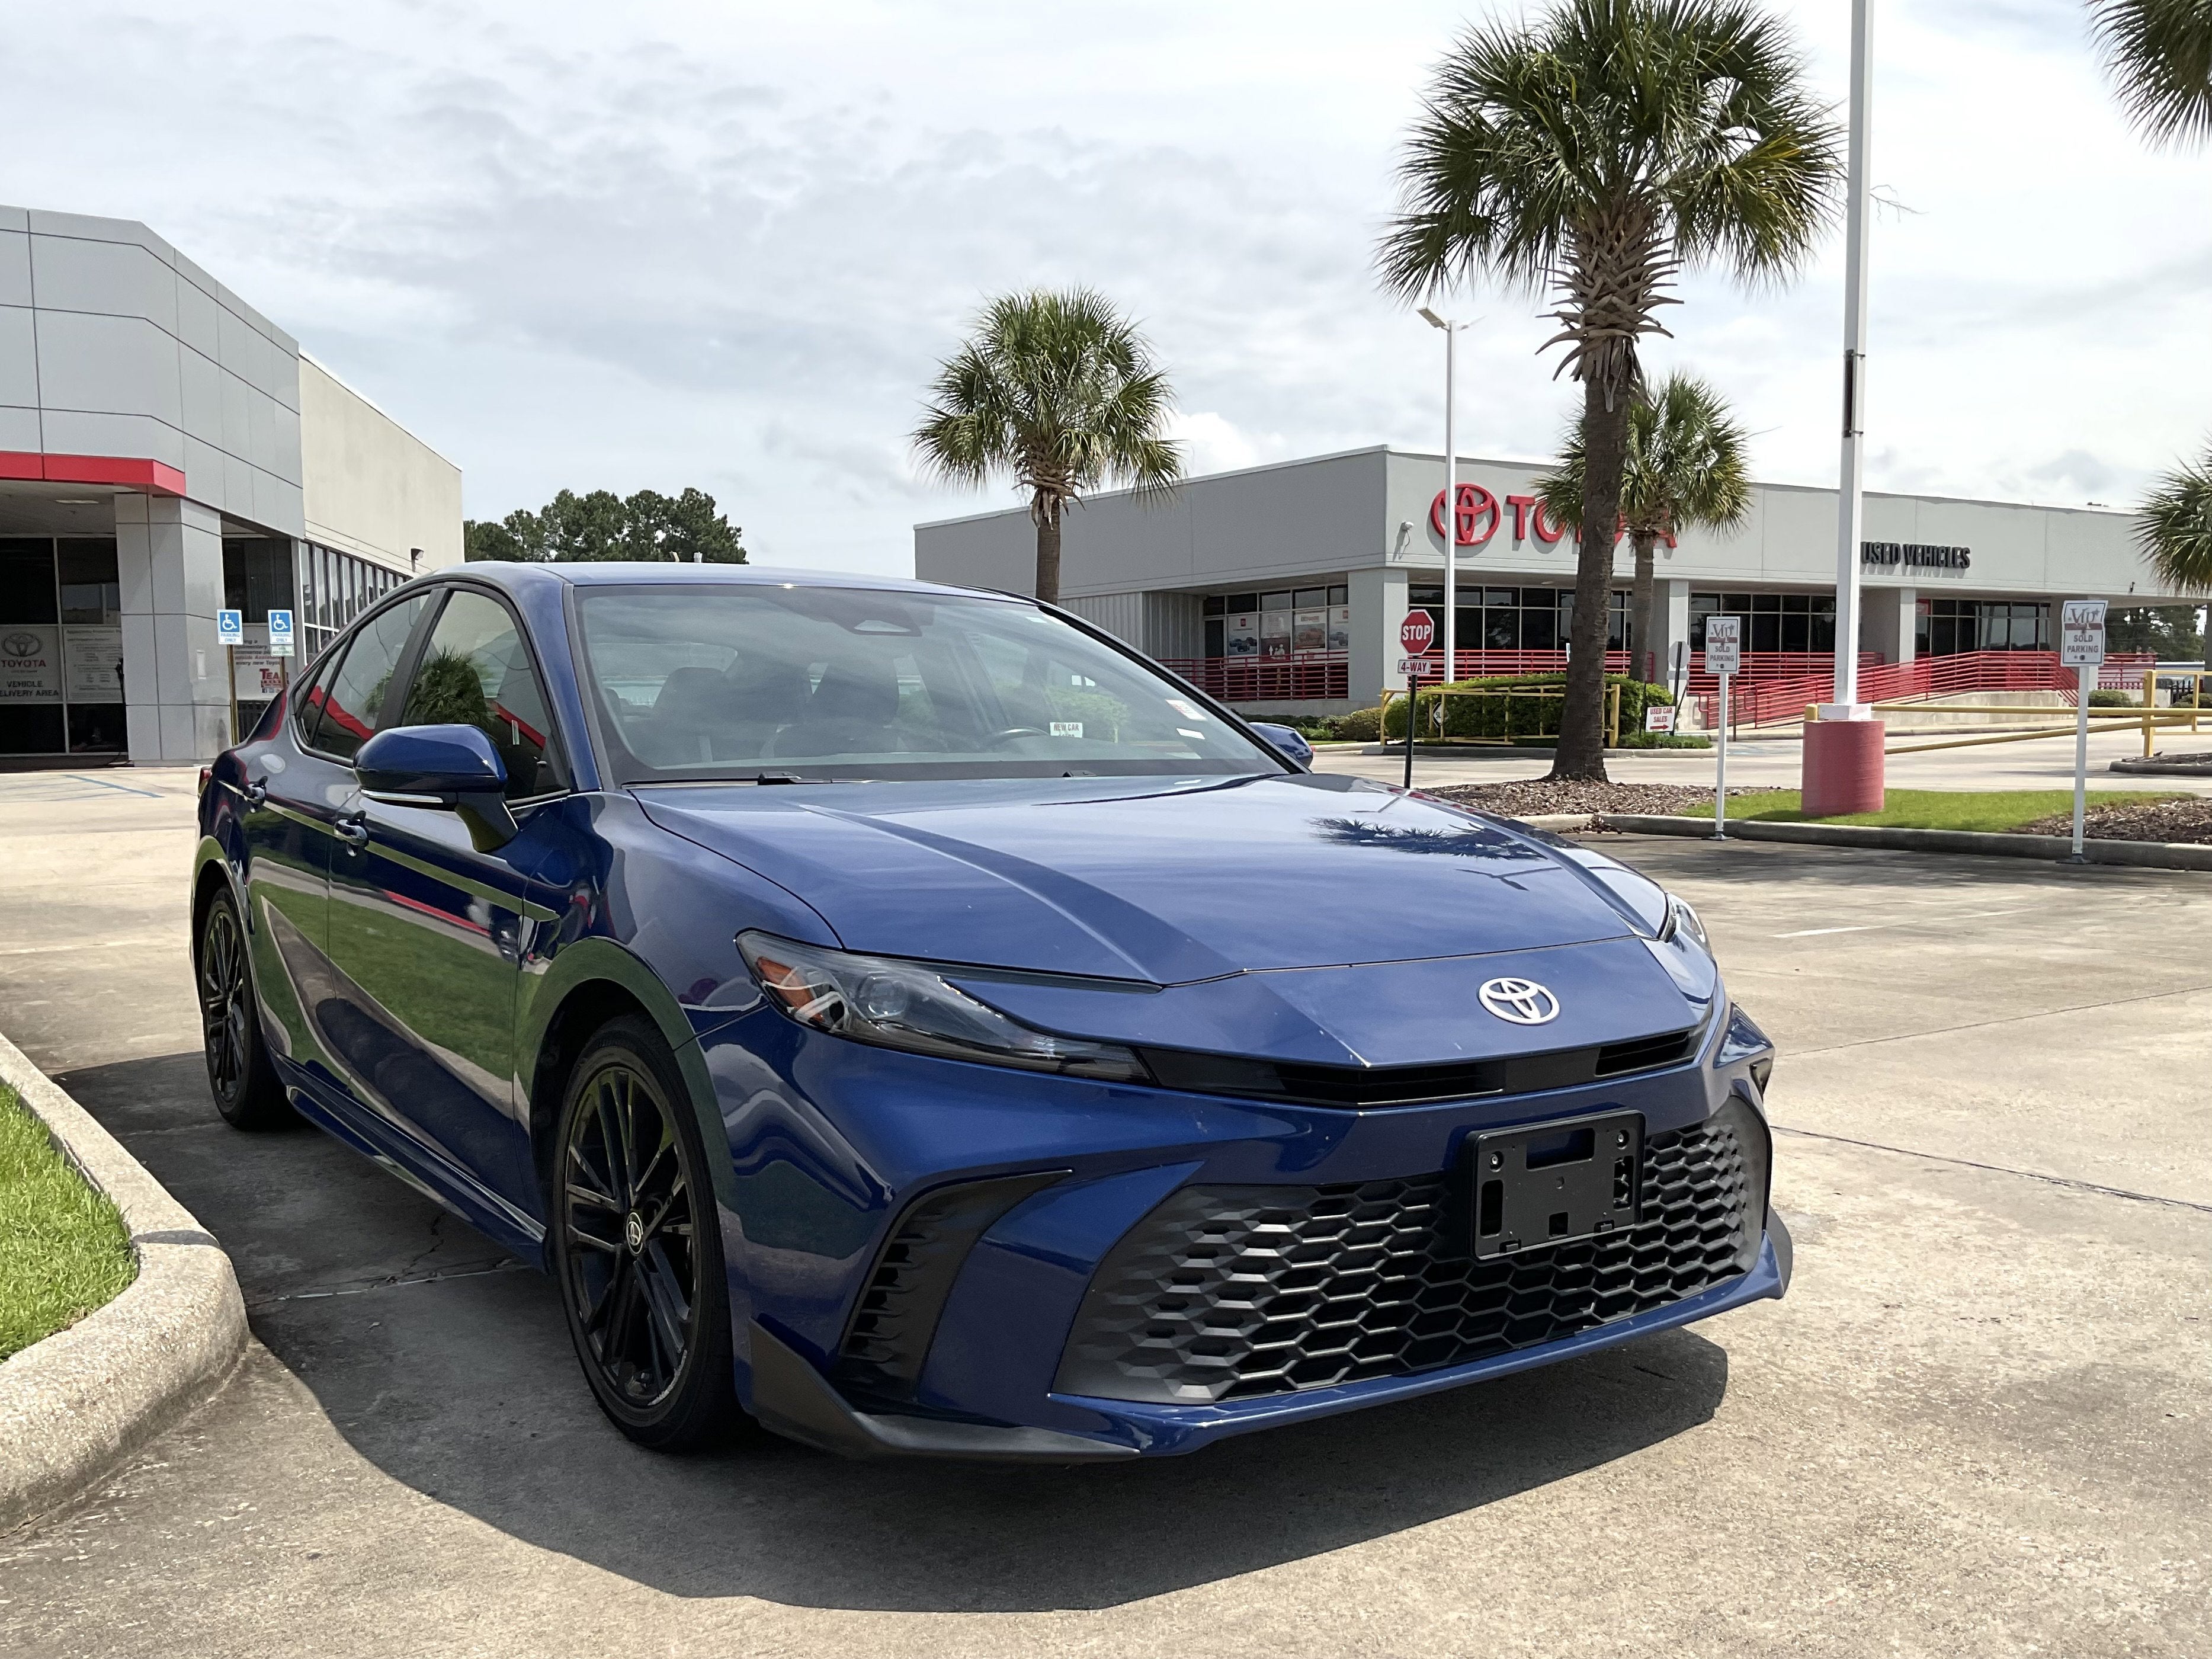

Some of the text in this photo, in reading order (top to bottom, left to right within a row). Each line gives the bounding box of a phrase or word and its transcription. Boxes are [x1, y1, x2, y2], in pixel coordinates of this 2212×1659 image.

[1860, 542, 1970, 569] USED VEHICLES
[1402, 624, 1431, 640] STOP
[1, 659, 46, 668] TOYOTA
[1401, 662, 1427, 672] 4-WAY
